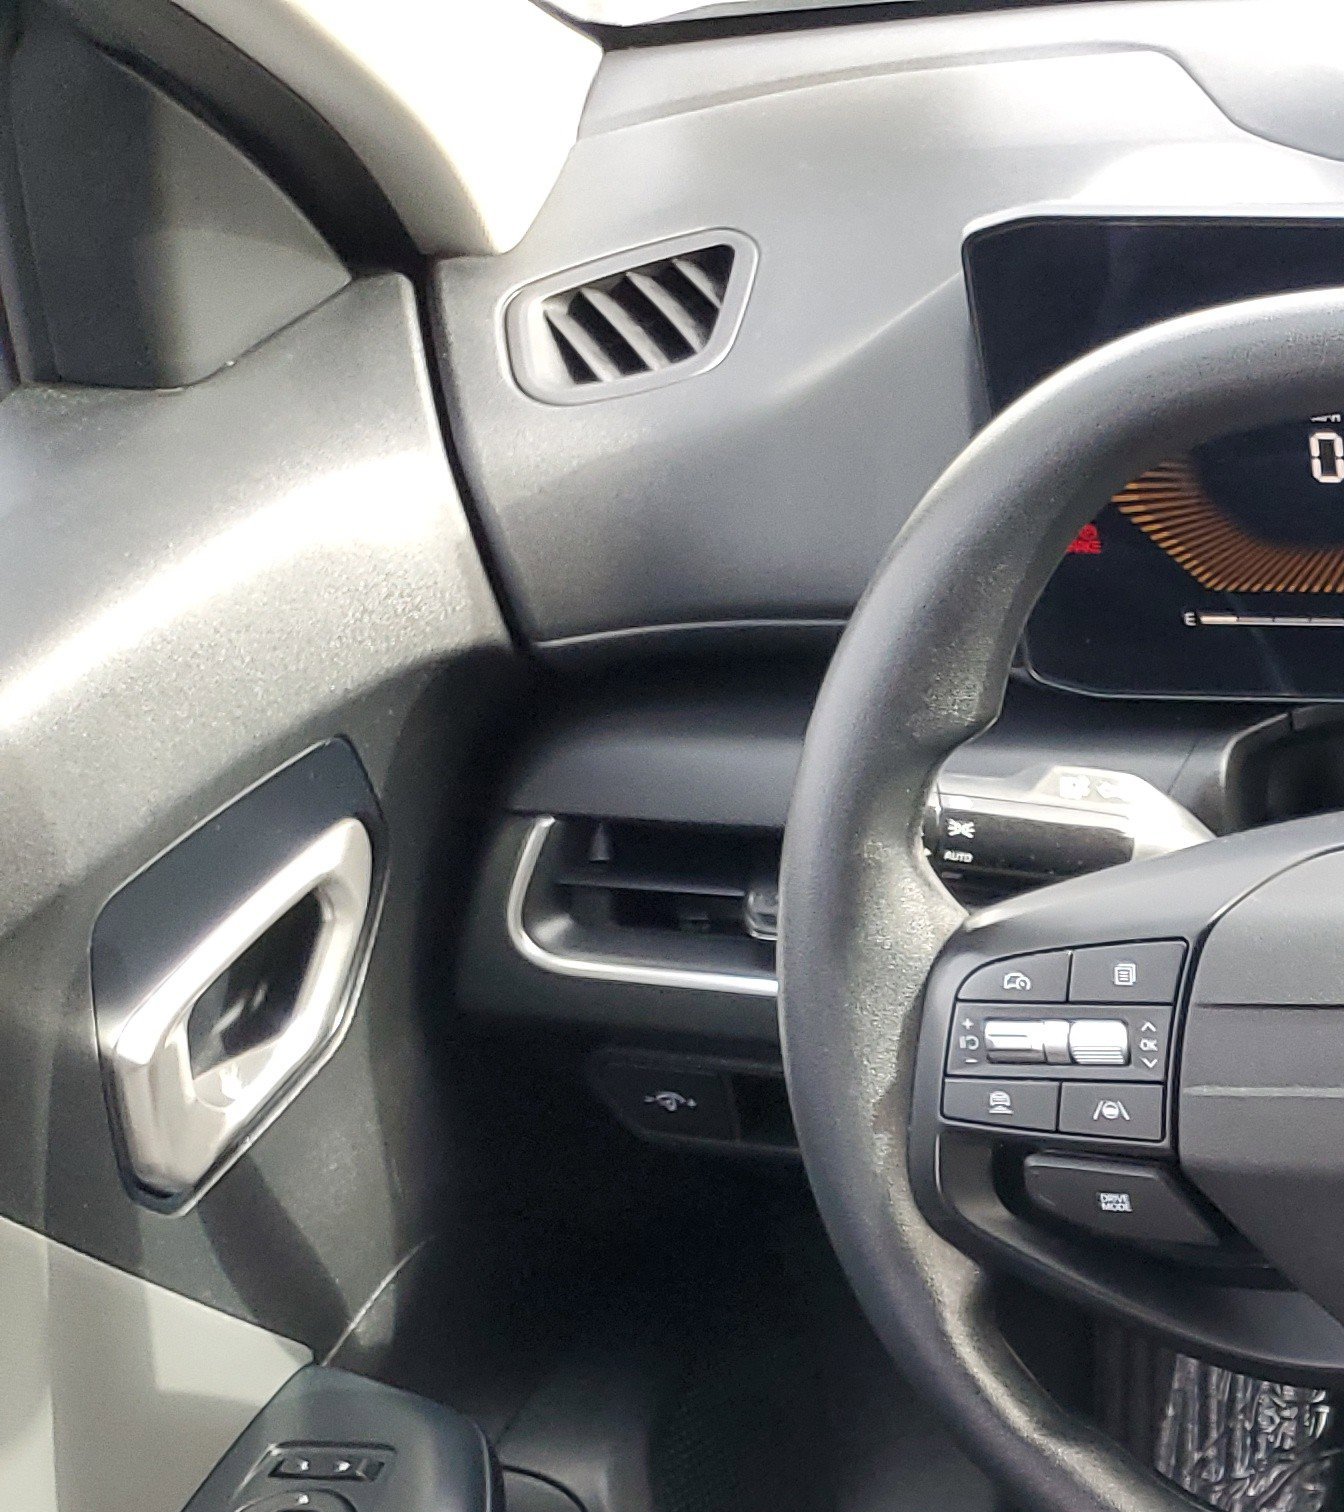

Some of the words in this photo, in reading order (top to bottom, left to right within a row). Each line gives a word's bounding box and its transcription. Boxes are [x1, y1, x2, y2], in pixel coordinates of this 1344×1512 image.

[1184, 612, 1196, 626] E
[942, 848, 974, 864] AUTO
[1139, 1038, 1158, 1052] OK
